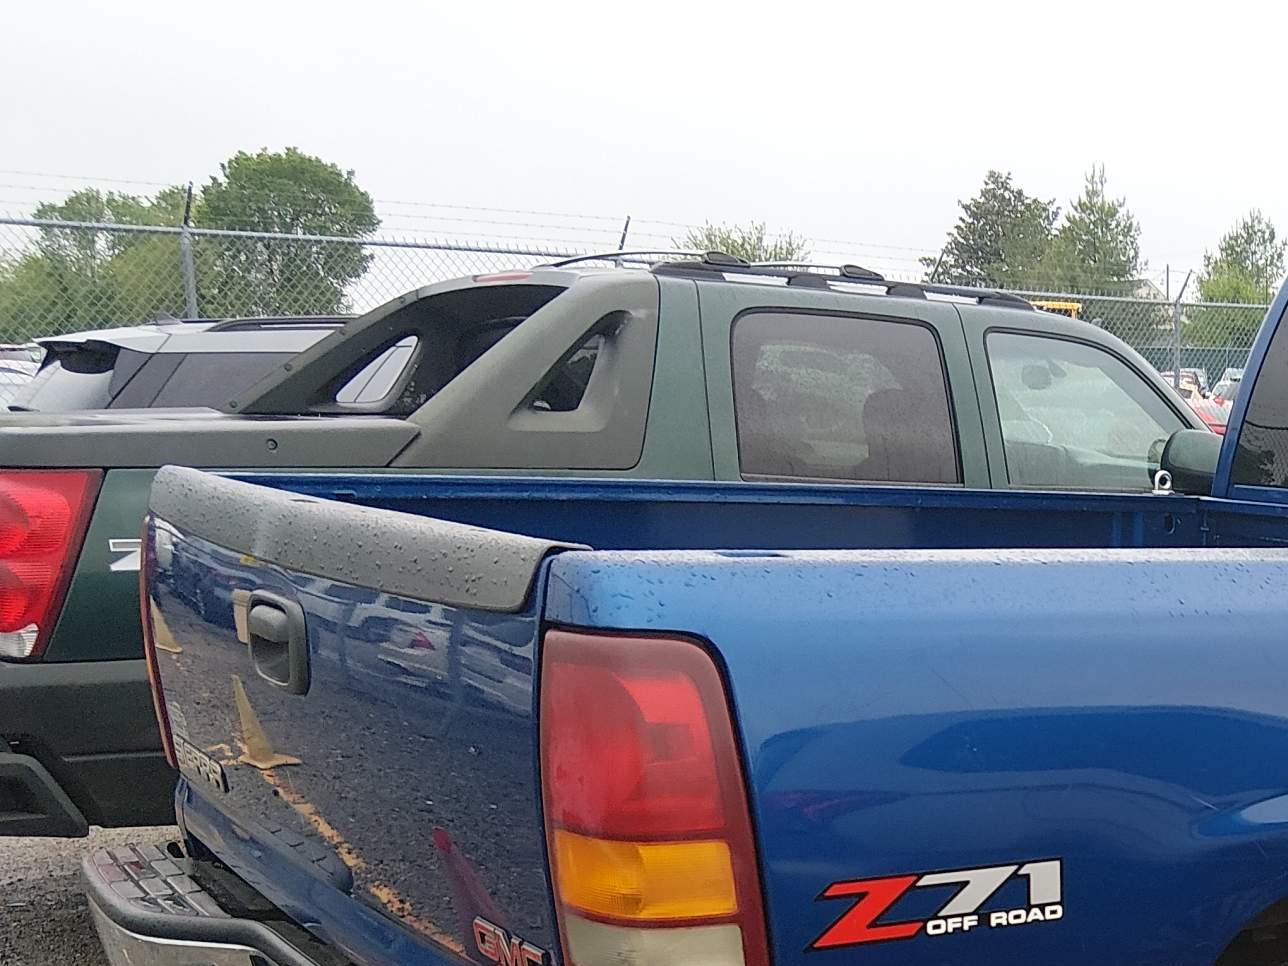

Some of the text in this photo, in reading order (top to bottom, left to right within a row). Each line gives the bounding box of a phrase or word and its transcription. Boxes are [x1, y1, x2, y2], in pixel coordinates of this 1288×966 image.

[808, 858, 1063, 951] Z71
[925, 904, 1064, 937] OFF ROAD
